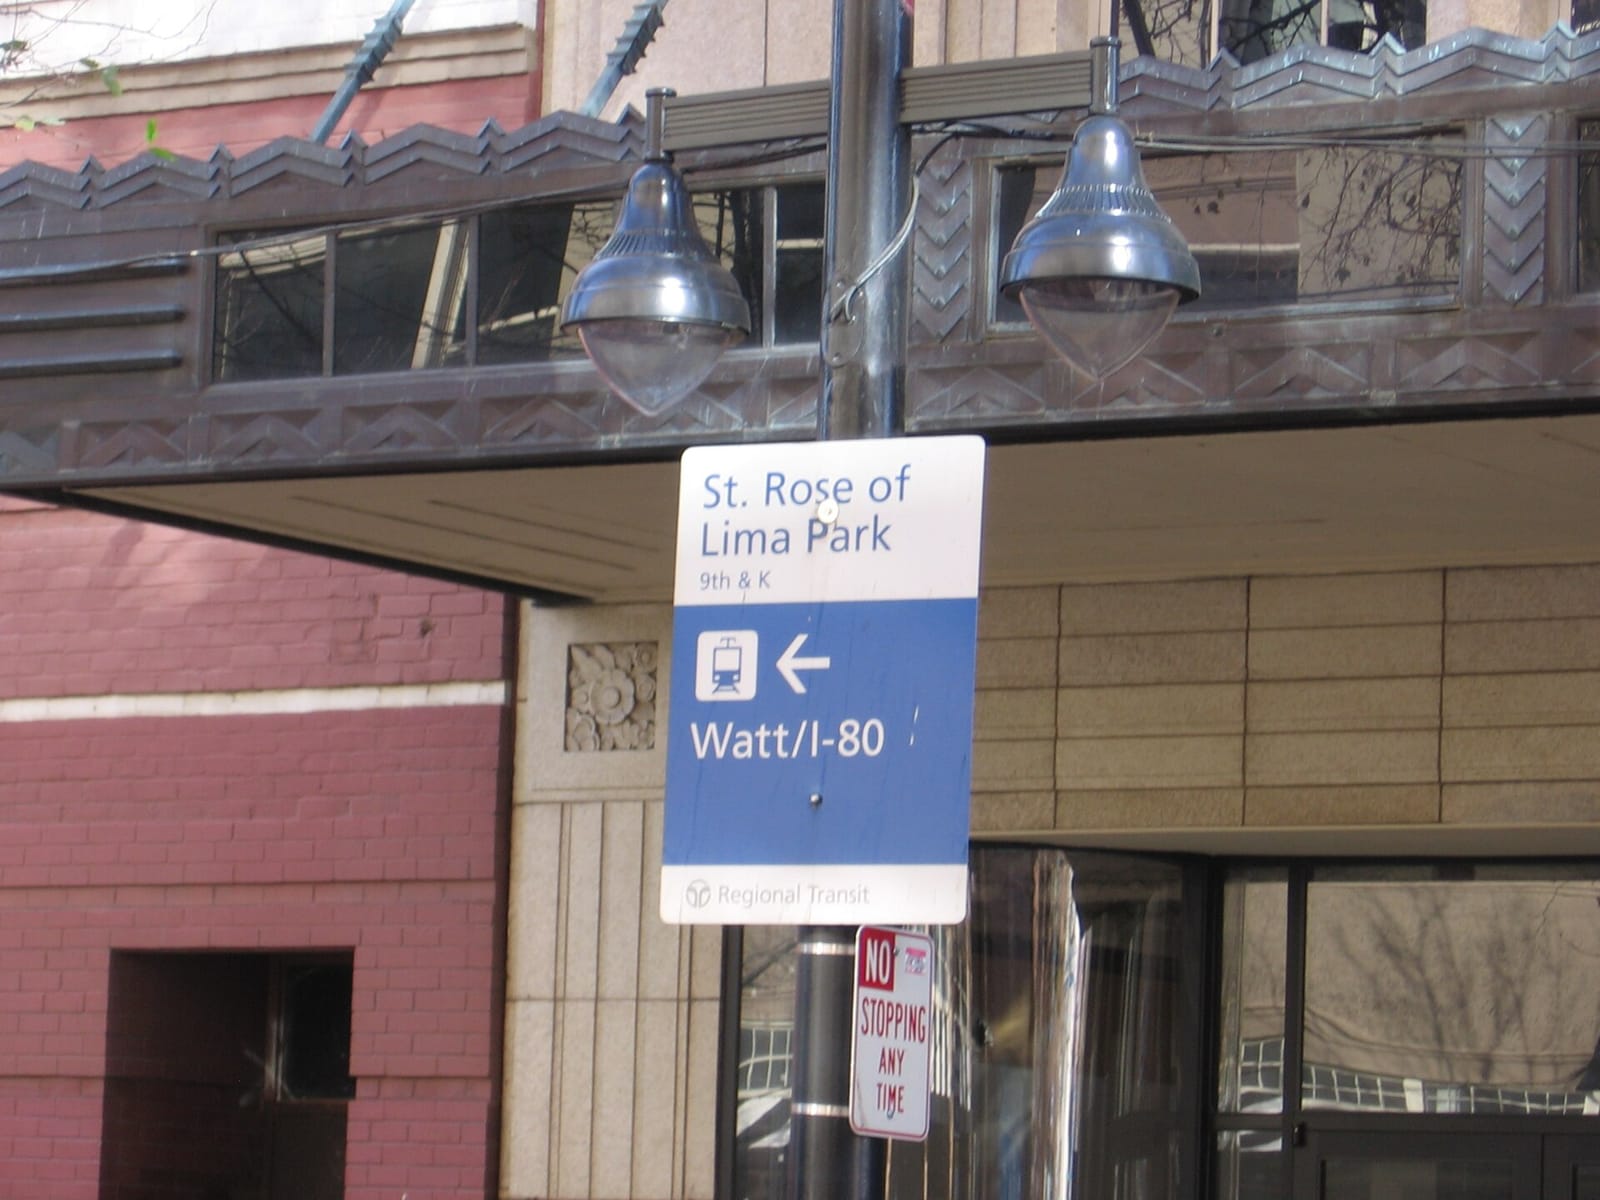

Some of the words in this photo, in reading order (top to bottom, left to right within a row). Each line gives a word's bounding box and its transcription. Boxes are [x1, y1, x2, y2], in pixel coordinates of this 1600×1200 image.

[703, 474, 748, 509] St.
[764, 471, 853, 507] Rose
[868, 463, 911, 503] of
[701, 520, 790, 556] Lima
[807, 513, 891, 554] Park
[699, 572, 730, 590] 9th
[738, 572, 751, 589] &
[758, 570, 771, 588] K
[690, 718, 886, 759] Watt/I-80
[718, 884, 801, 907] Regional
[808, 884, 870, 905] Transit
[865, 937, 891, 985] NO
[861, 997, 926, 1043] STOPPING
[878, 1047, 905, 1077] ANY
[876, 1083, 905, 1114] TIME
